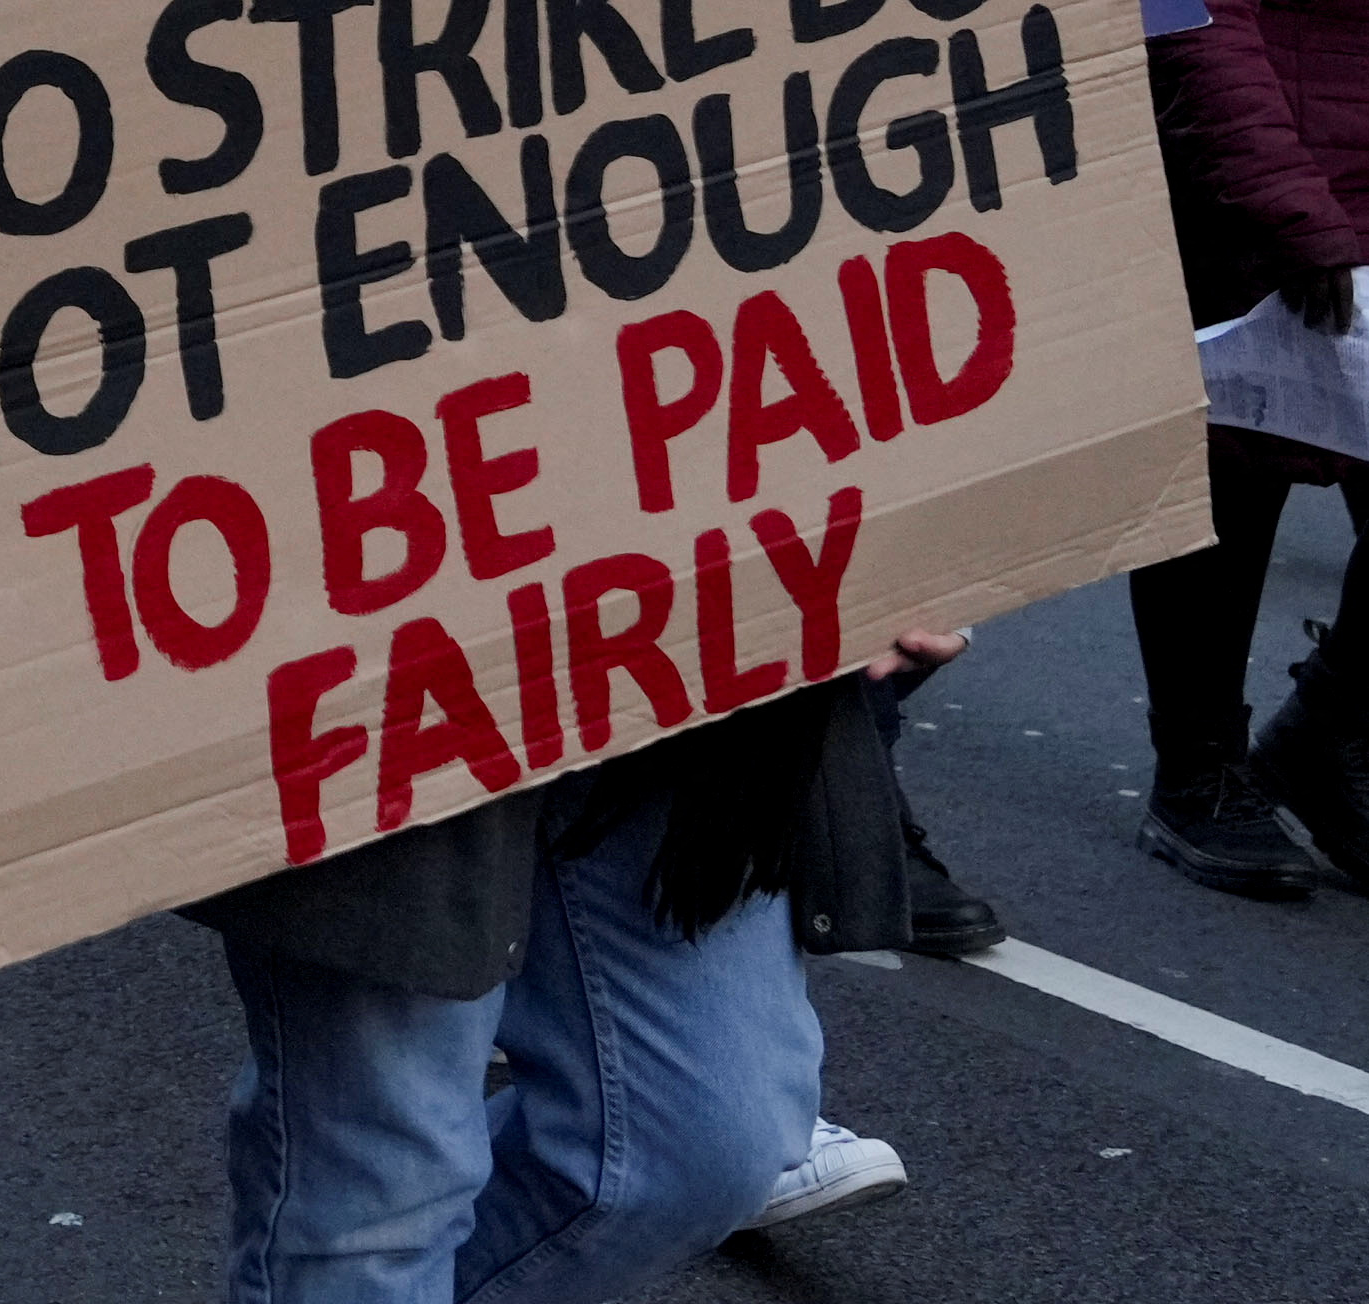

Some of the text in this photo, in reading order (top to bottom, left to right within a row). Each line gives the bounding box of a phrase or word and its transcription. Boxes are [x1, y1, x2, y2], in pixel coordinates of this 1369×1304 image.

[314, 4, 1078, 380] ENOUGH
[21, 462, 271, 682] TO
[309, 370, 556, 617] BE
[615, 230, 1016, 514] PAID
[267, 485, 864, 867] FAIRLY
